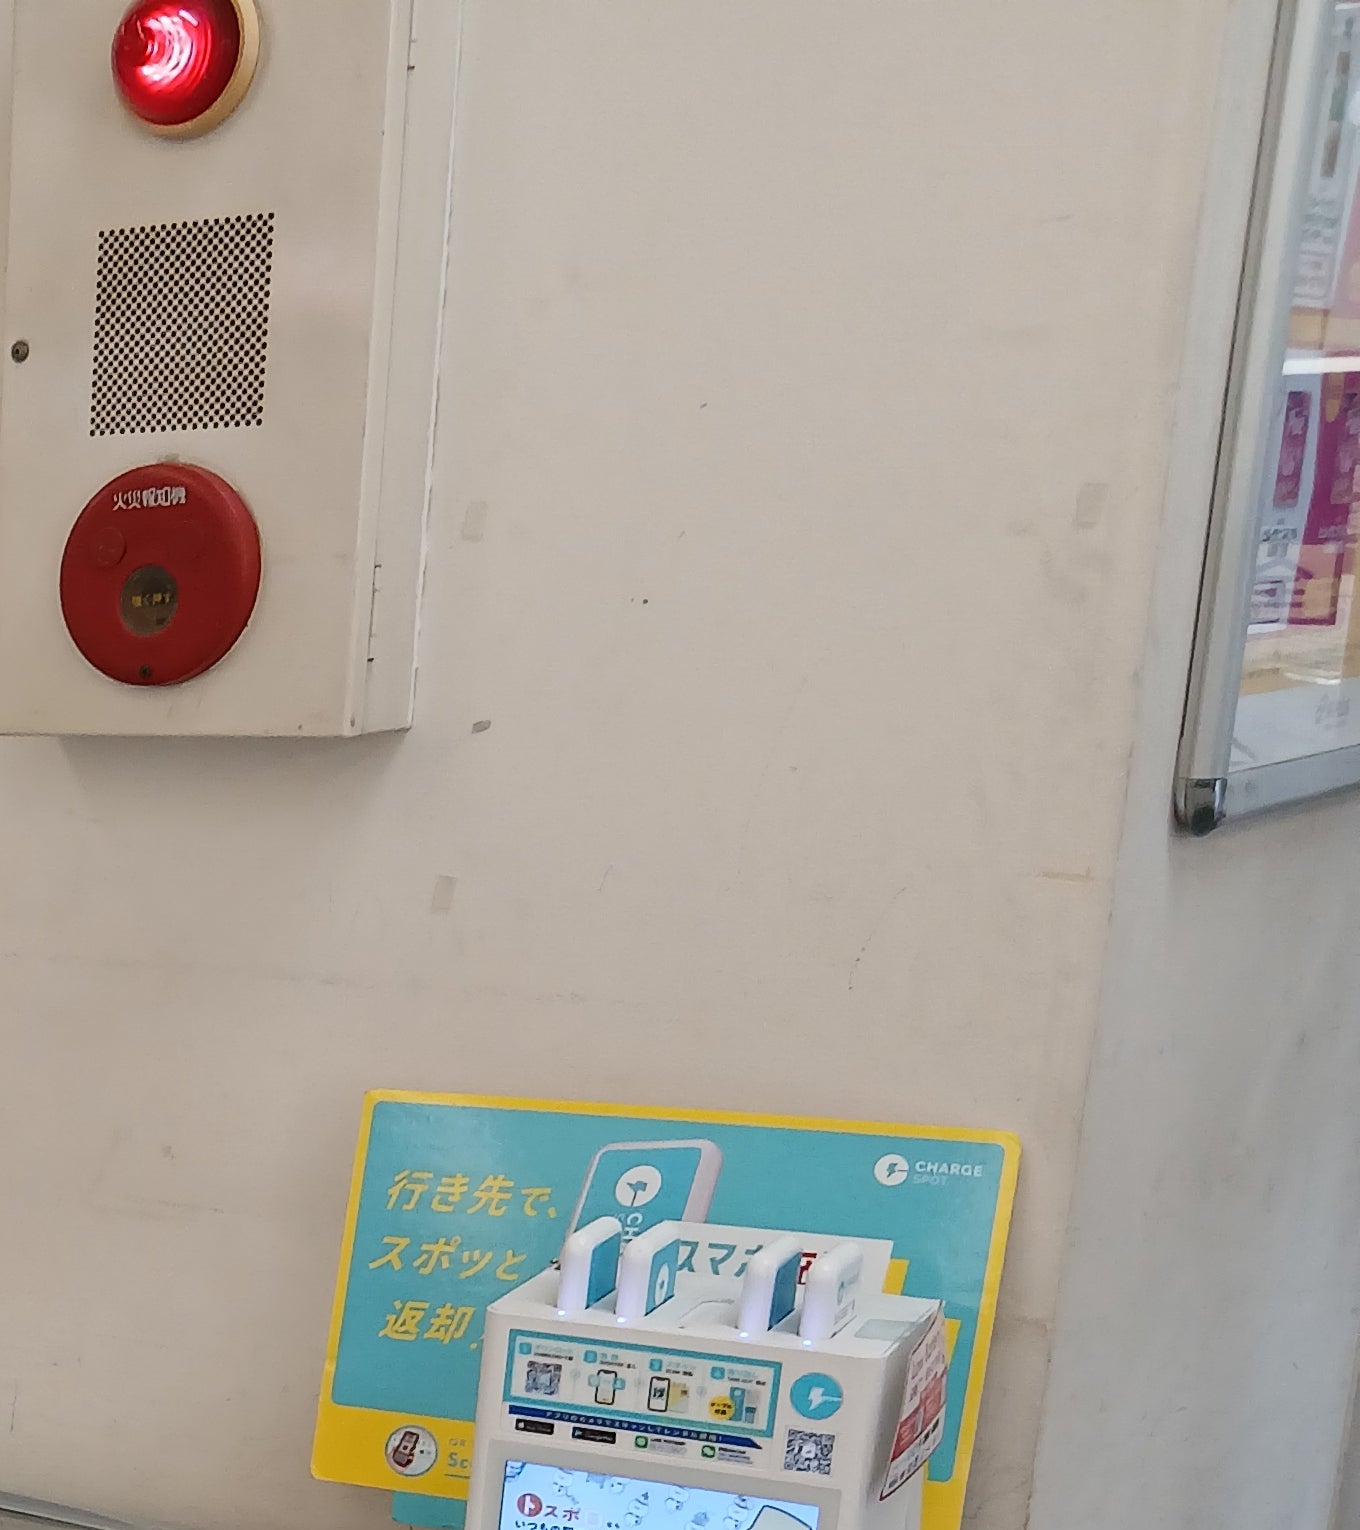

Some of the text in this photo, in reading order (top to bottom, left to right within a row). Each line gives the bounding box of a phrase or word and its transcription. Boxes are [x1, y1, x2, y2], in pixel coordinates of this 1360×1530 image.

[912, 1173, 948, 1186] SPOT
[915, 1161, 983, 1178] CHARGE
[385, 1169, 559, 1219] 行き先で、
[367, 1235, 527, 1282] スポッと
